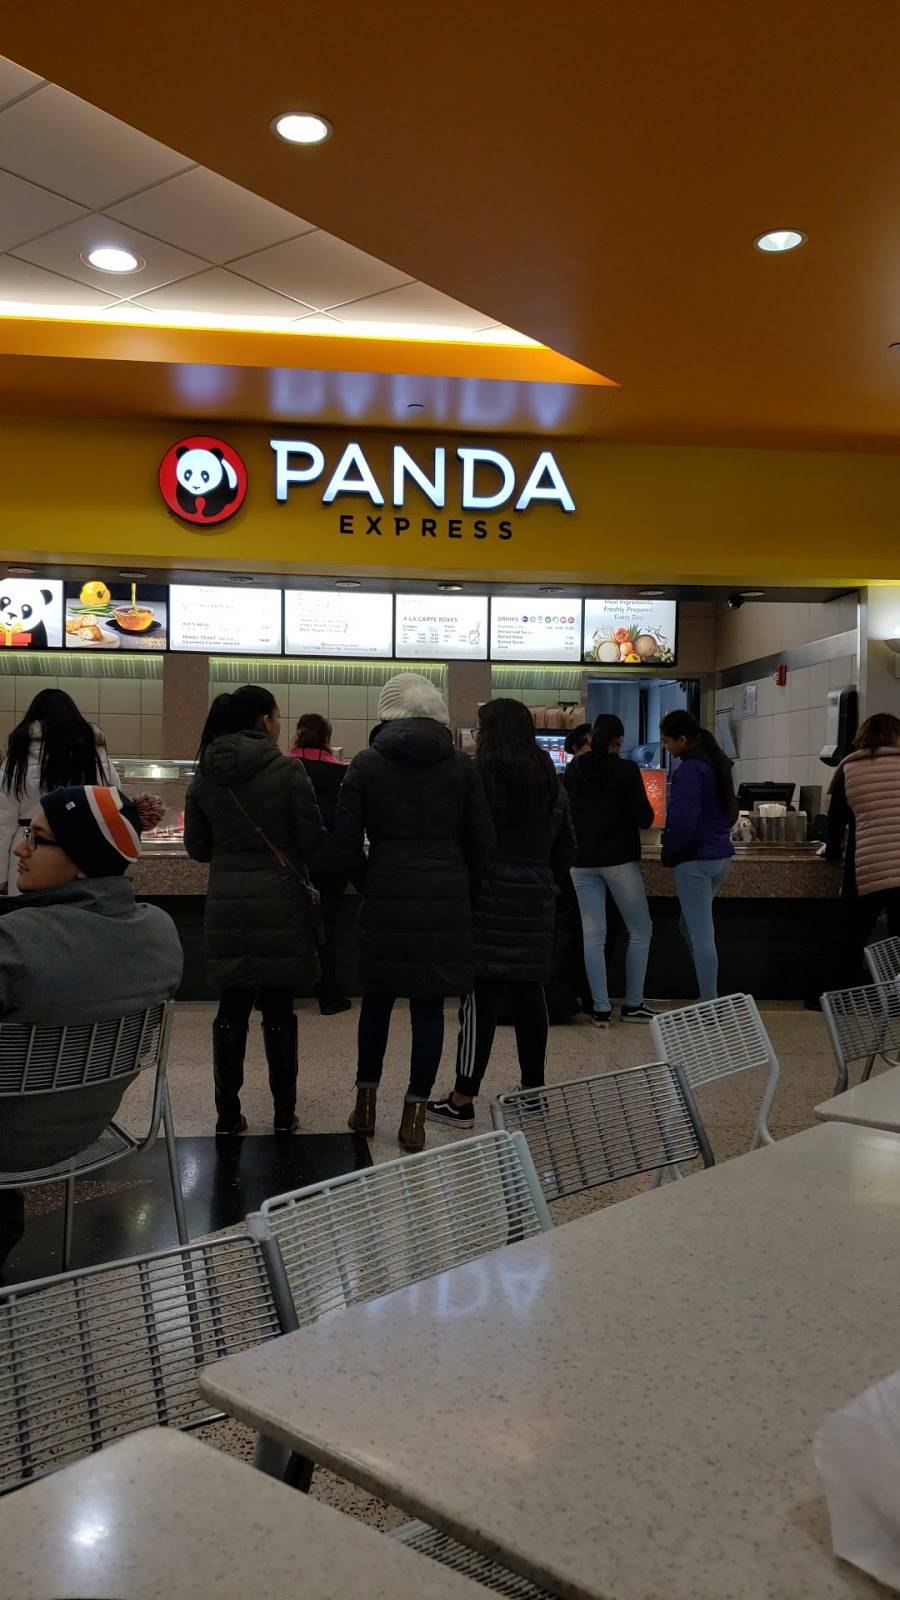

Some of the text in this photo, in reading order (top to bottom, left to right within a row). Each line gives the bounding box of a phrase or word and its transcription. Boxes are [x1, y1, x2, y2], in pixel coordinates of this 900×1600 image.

[269, 439, 577, 514] PANDA
[338, 514, 513, 541] EXPRESS
[603, 606, 625, 614] Freshly
[438, 616, 458, 624] BOXES
[614, 613, 631, 621] Every
